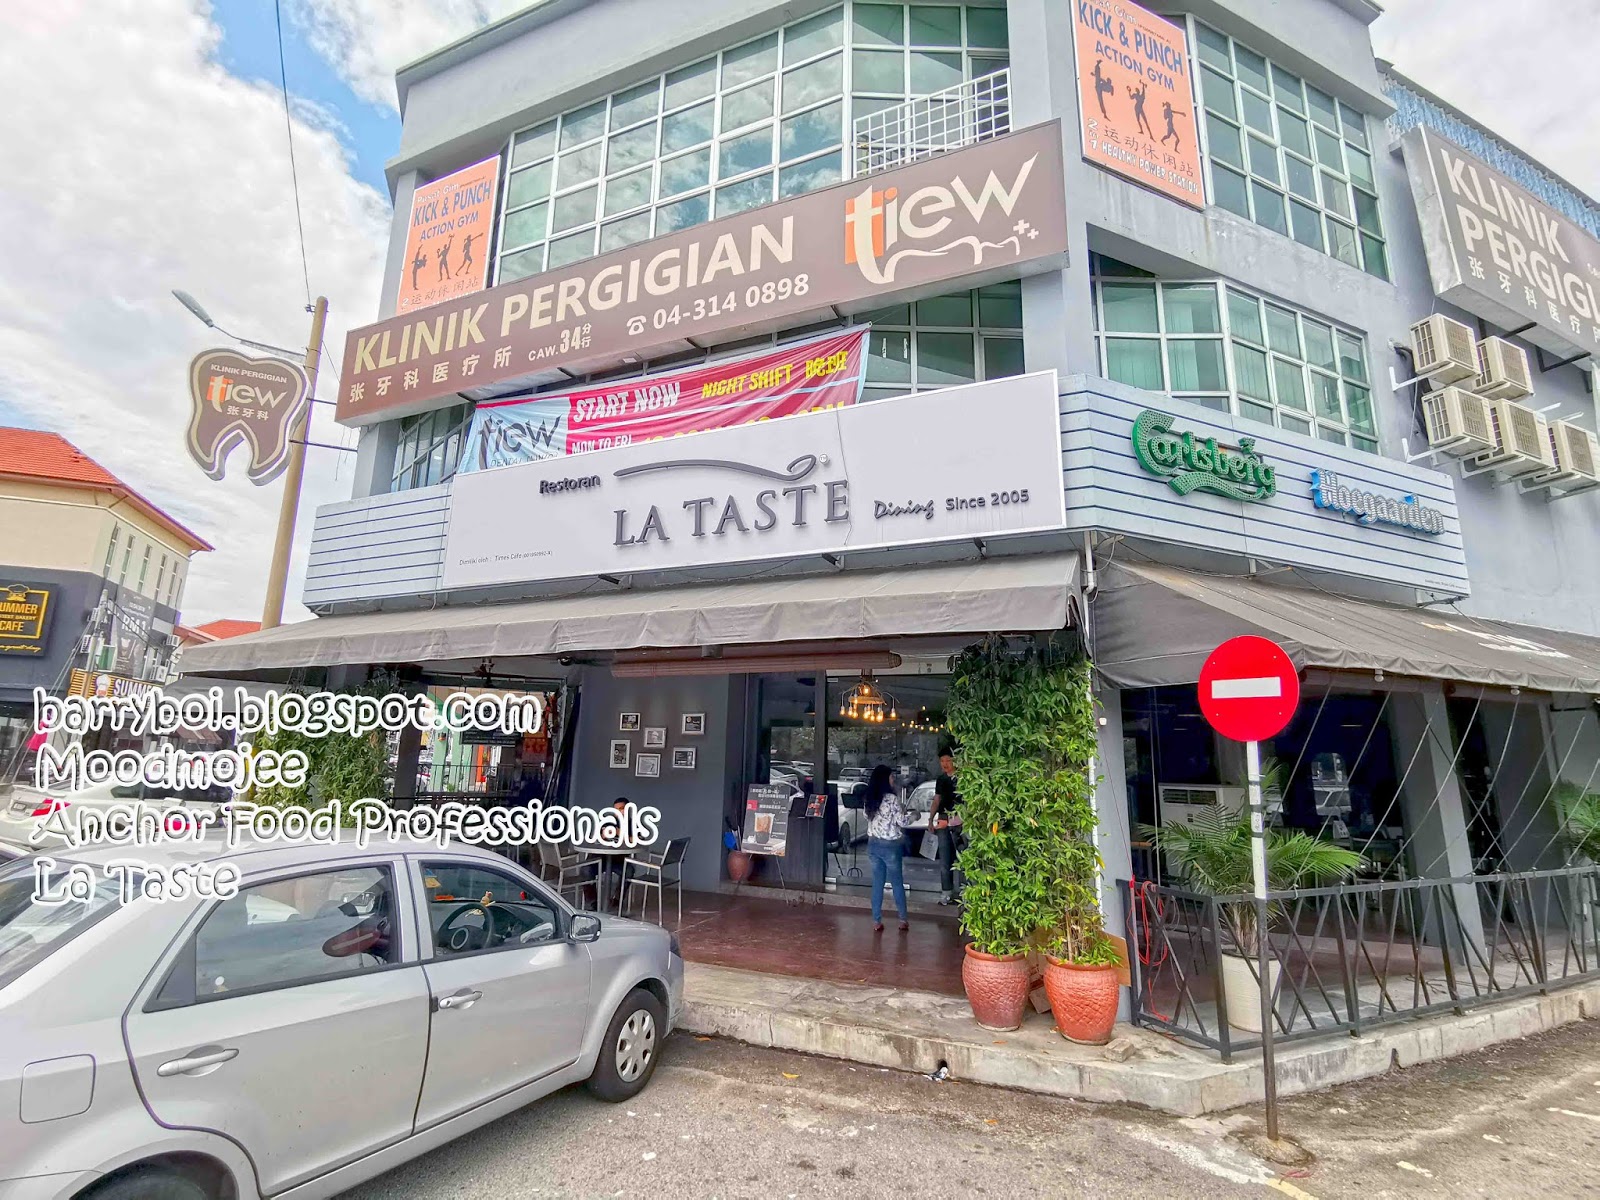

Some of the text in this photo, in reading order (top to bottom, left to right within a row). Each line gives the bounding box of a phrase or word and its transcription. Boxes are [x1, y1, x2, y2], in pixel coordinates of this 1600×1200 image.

[1078, 1, 1115, 41] KICK
[1119, 21, 1130, 49] &
[1133, 28, 1184, 77] PUNCH
[1095, 40, 1175, 92] ACTION GYM
[1102, 141, 1198, 195] HEALTHY POWER STATION
[1103, 125, 1194, 178] 运动休闲站
[413, 200, 439, 228] KICK
[441, 197, 449, 217] &
[453, 180, 492, 213] PUNCH
[420, 211, 479, 242] ACTION GYM
[1441, 148, 1570, 264] KLINIK
[353, 215, 794, 375] KLINIK PERGIGIAN
[652, 274, 809, 330] 04-314 0898
[528, 326, 582, 362] CAW. 34
[210, 363, 288, 384] KLINIK PERGIGIAN
[349, 346, 511, 403] 张牙科医疗所
[702, 363, 794, 398] NIGHT SHIFT
[226, 405, 269, 421] 张牙科
[573, 391, 631, 423] START
[634, 381, 681, 413] NOW
[1132, 409, 1277, 500] Carlsberg
[539, 474, 601, 495] Restoran
[874, 489, 1030, 521] Dining Since 2005
[1309, 467, 1446, 536] Hoegaarden
[613, 479, 850, 547] LA TASTE
[0, 602, 38, 614] UMMER
[0, 620, 25, 632] CAFE
[113, 678, 153, 701] SUMM
